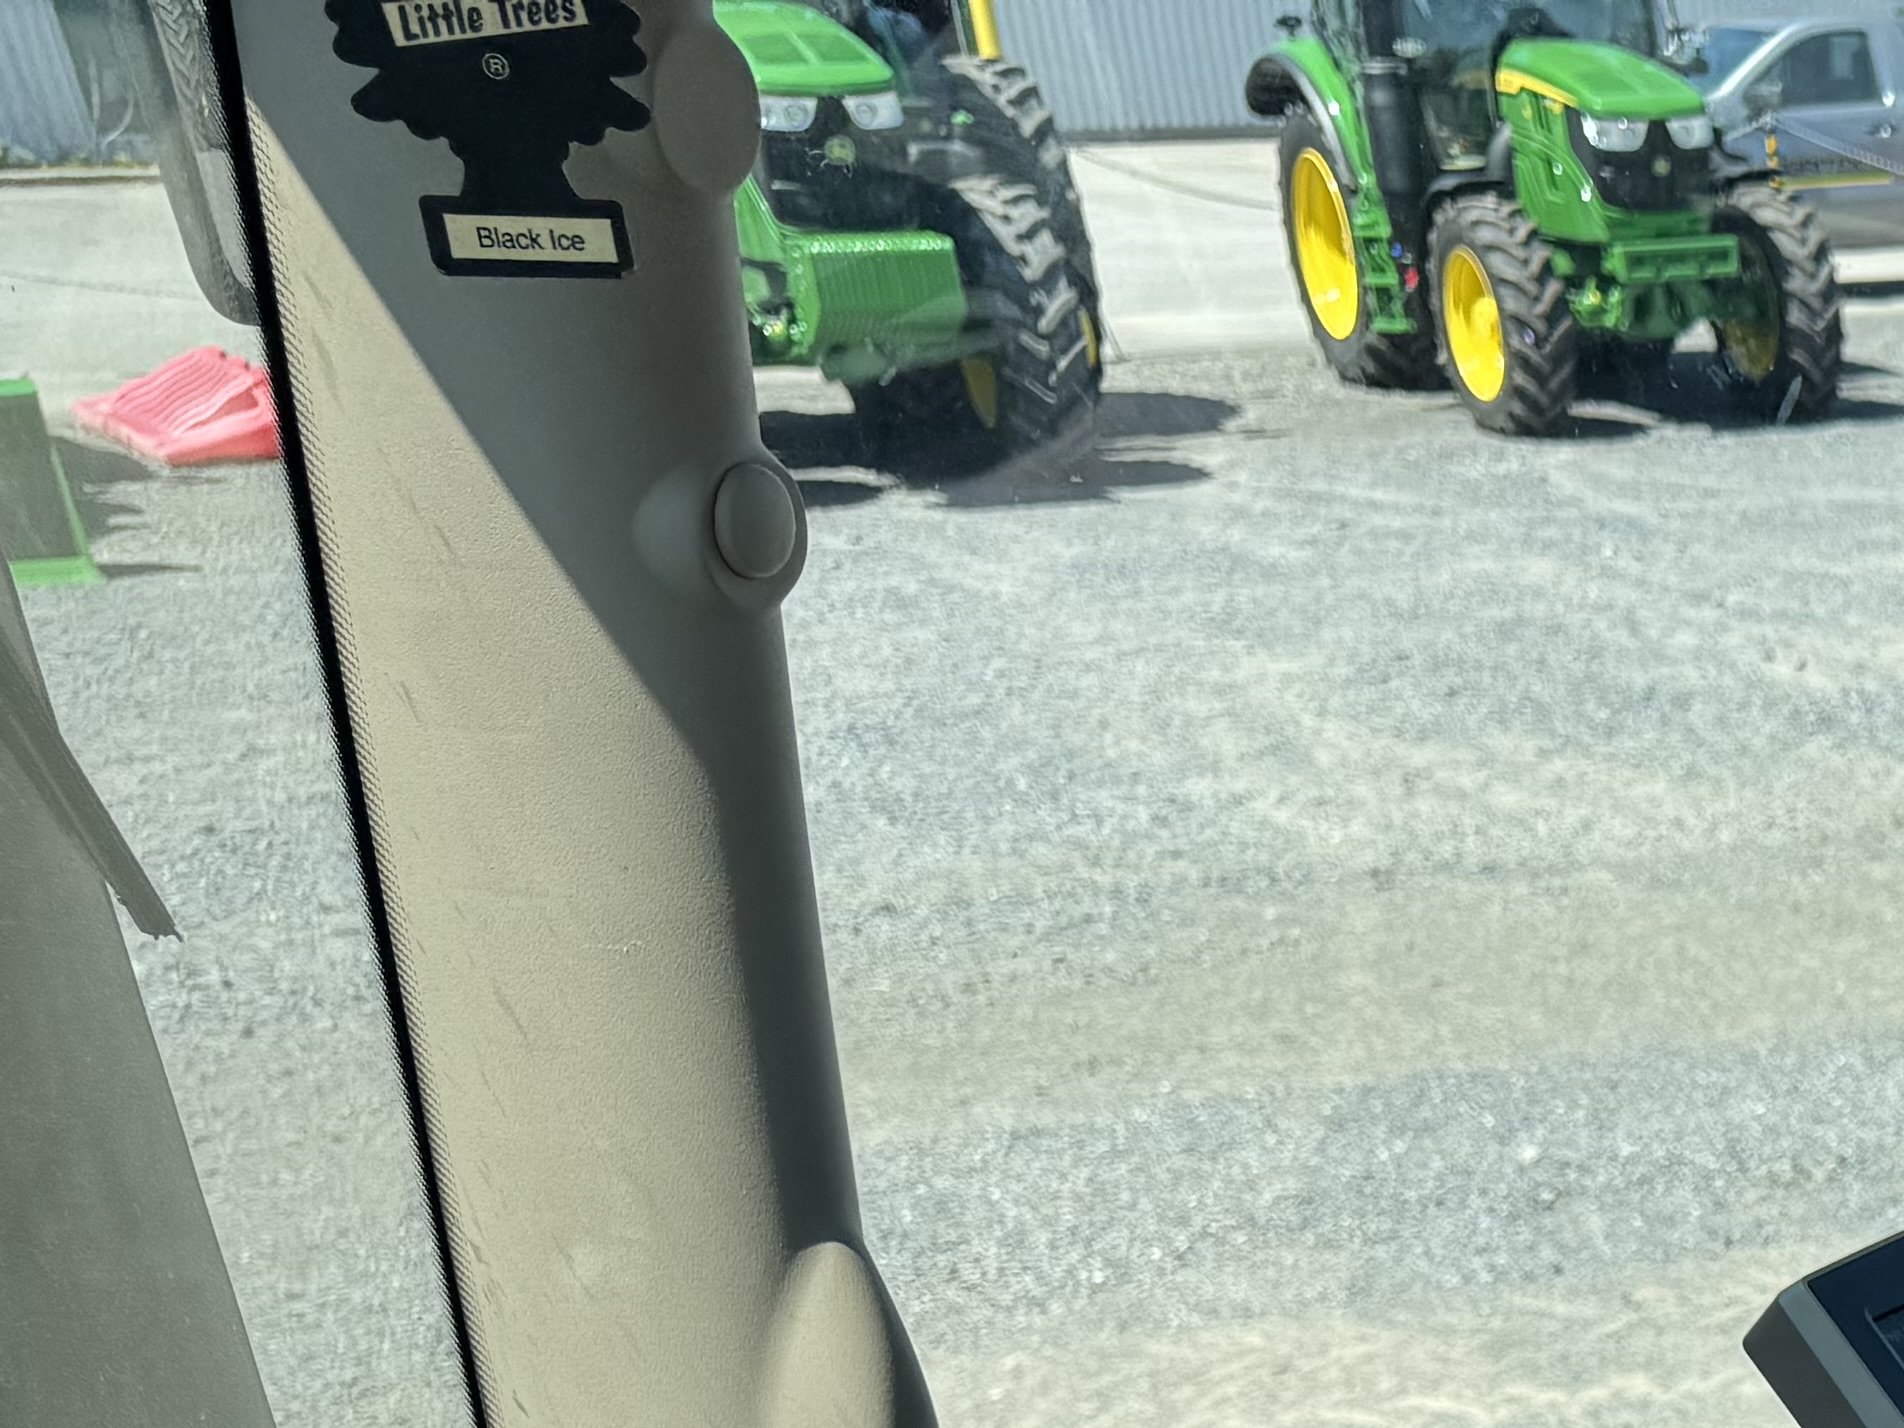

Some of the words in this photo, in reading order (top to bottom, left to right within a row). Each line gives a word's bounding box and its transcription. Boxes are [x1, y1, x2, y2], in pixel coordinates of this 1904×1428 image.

[398, 1, 484, 42] Little
[489, 0, 577, 29] Trees
[476, 226, 545, 251] Black
[549, 229, 586, 251] Ice
